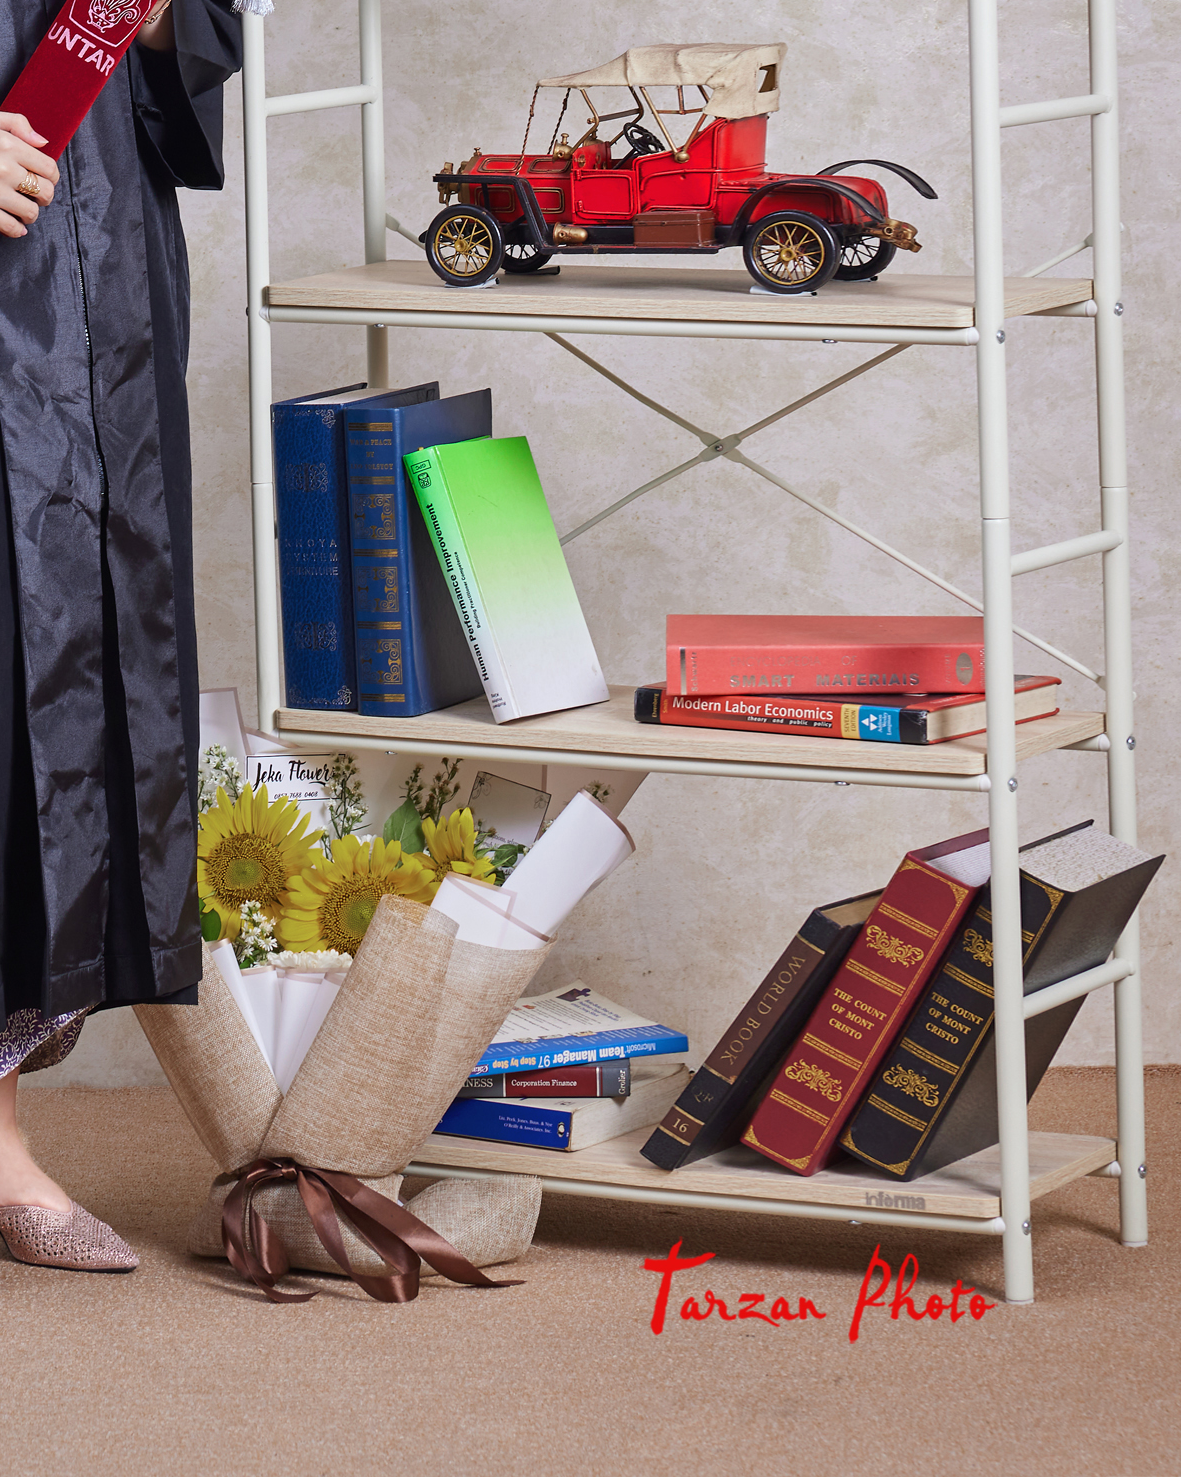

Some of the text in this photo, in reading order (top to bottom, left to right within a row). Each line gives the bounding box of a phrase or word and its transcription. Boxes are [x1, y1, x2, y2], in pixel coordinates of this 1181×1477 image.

[48, 22, 115, 77] UNTAR
[286, 553, 338, 562] YSTEM
[426, 503, 489, 682] Human Performance Improvement
[730, 655, 858, 667] ENCYCLOPEDIA OF
[730, 674, 795, 688] SMART
[672, 697, 834, 721] Modern Labor Economics
[747, 715, 767, 723] theory
[813, 721, 833, 729] policy
[253, 762, 284, 792] Jeka
[721, 956, 807, 1066] WORLD BOOK
[833, 987, 888, 1021] THE COUNT
[931, 991, 984, 1026] THE COUNT
[831, 1003, 875, 1031] OF MONT
[928, 1007, 972, 1035] OF MONT
[828, 1018, 863, 1040] CRISTO
[925, 1022, 960, 1045] CRISTO
[599, 1046, 626, 1058] Team
[626, 1042, 656, 1054] Microsoft
[492, 1060, 509, 1069] Step
[510, 1059, 519, 1068] by
[520, 1057, 537, 1066] Step
[537, 1055, 551, 1069] 97
[552, 1049, 597, 1064] Manager
[464, 1078, 578, 1088] NESS Corporation Finance
[618, 1069, 627, 1095] Grolier
[672, 1118, 689, 1134] 16
